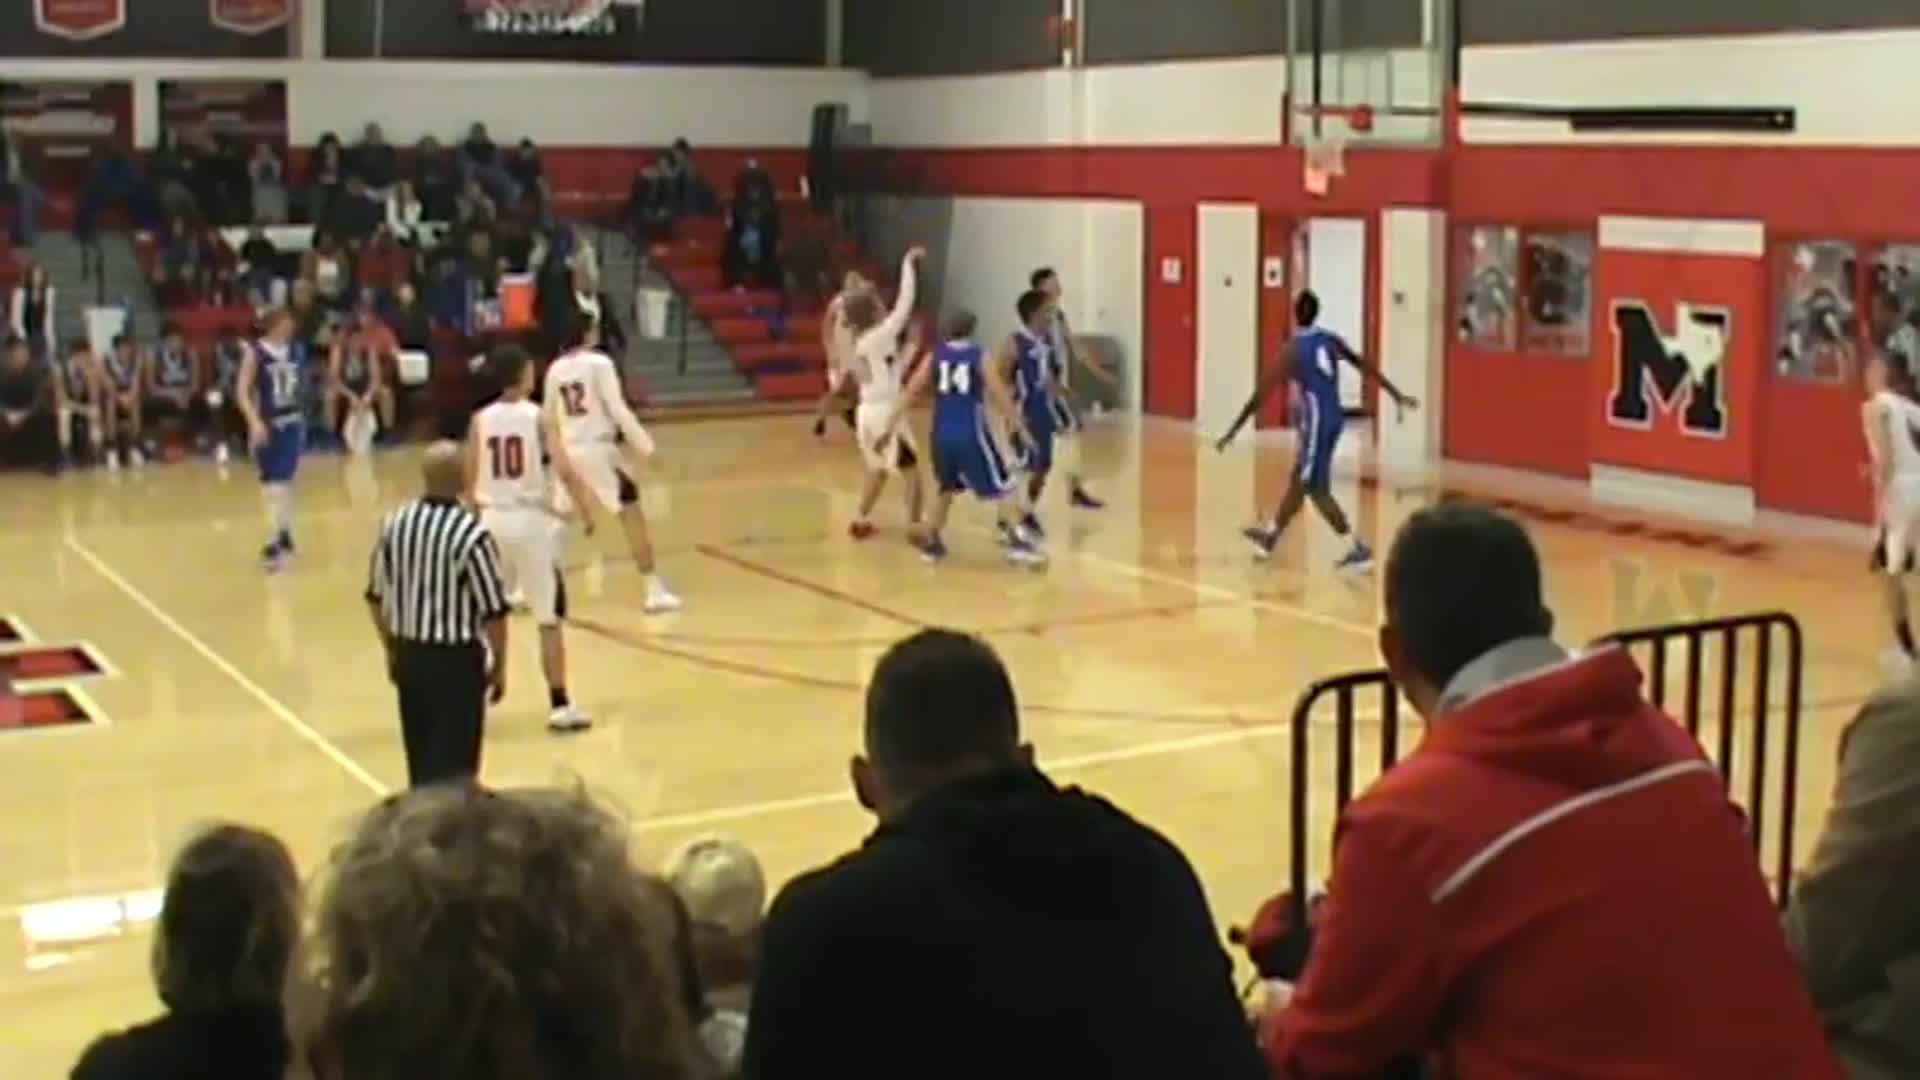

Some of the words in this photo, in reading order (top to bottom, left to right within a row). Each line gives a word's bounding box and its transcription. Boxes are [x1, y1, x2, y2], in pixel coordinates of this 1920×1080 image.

[937, 360, 972, 394] 14
[1606, 297, 1732, 439] M
[559, 381, 588, 417] 12
[487, 435, 525, 480] 10
